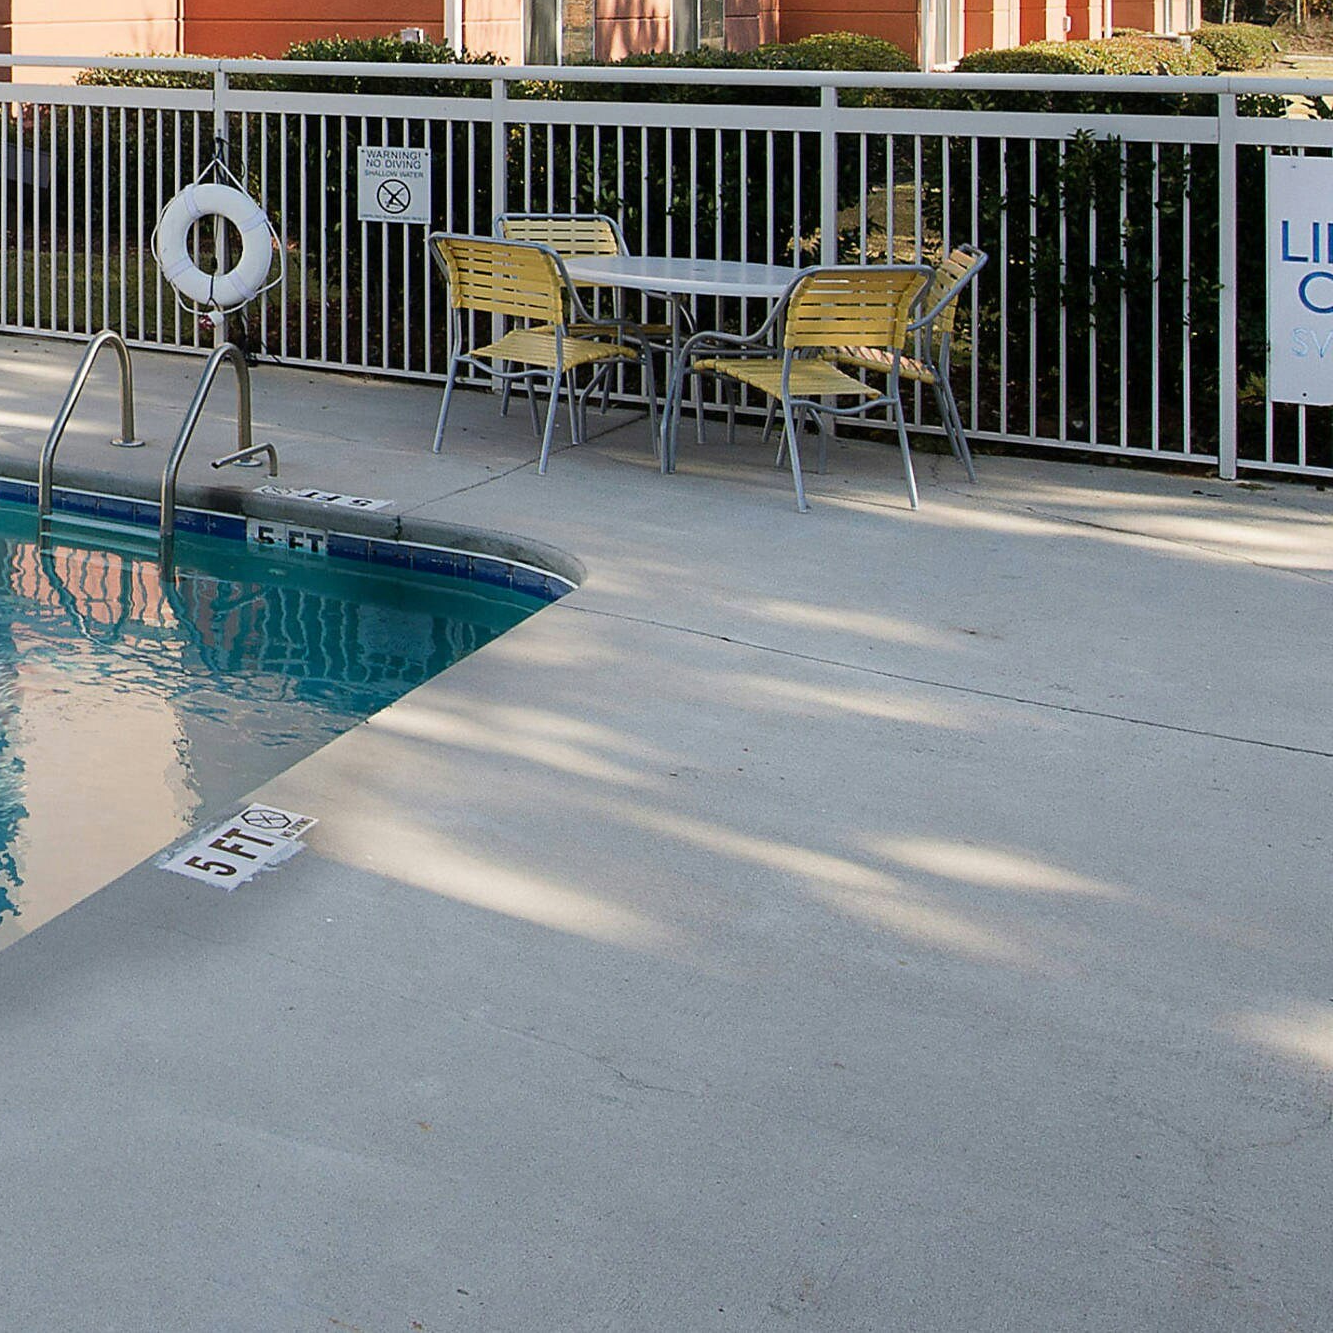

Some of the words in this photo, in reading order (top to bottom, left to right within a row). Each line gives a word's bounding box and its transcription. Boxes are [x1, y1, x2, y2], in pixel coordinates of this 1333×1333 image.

[366, 150, 421, 161] WARNING!
[366, 159, 381, 168] NO
[384, 160, 422, 170] DIVING
[1281, 220, 1333, 264] LI
[257, 525, 275, 545] 5
[288, 529, 324, 554] FT
[208, 827, 275, 861] FT
[184, 855, 238, 877] 5
